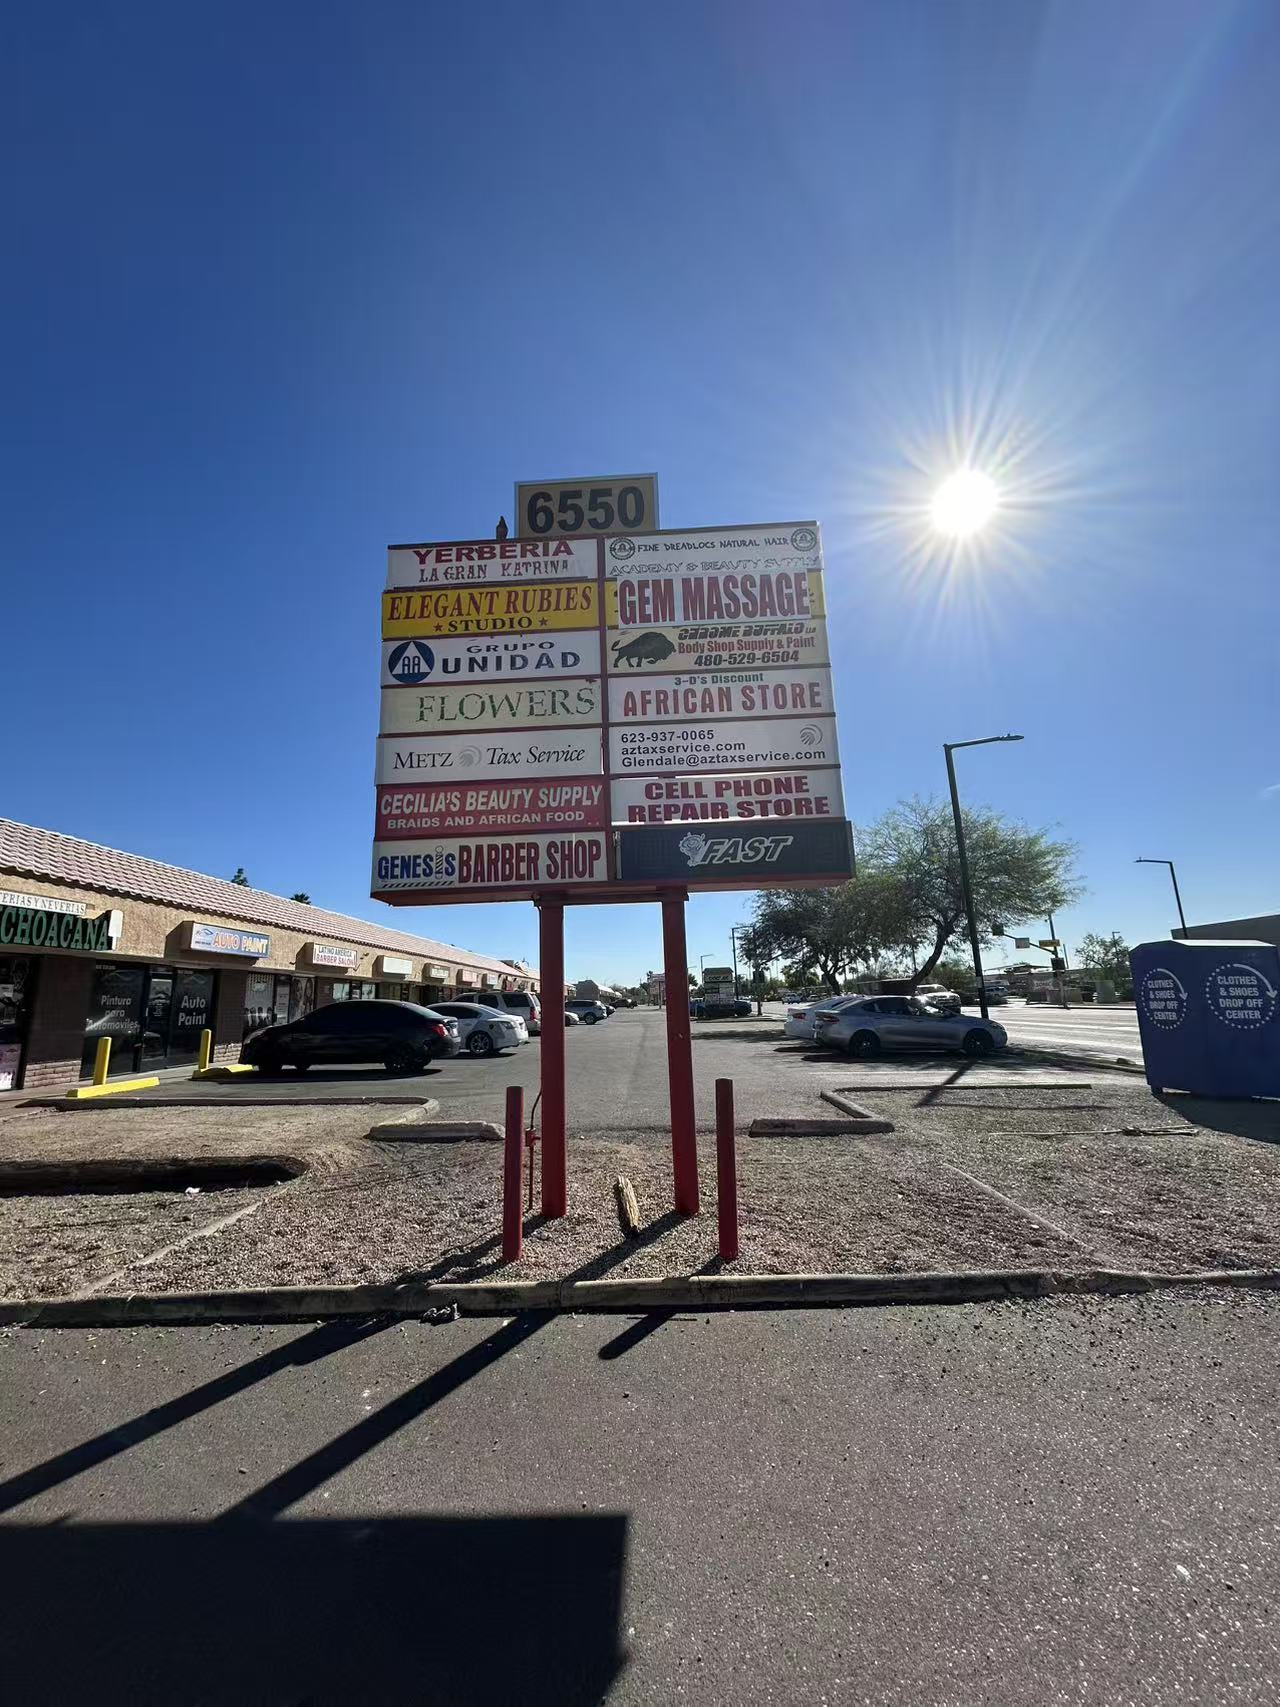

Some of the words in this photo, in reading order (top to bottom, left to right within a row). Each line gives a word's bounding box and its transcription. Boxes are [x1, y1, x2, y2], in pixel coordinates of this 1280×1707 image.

[527, 486, 645, 534] 6550
[412, 540, 574, 565] YERBERIA
[637, 543, 660, 553] FINE
[663, 541, 716, 551] DREADLOCS
[719, 539, 760, 549] NATURAL
[764, 537, 789, 546] HAIR
[418, 567, 439, 583] LA
[443, 564, 487, 581] GRAN
[500, 559, 569, 577] KATRINA
[609, 562, 683, 577] ACADEMY
[685, 562, 698, 571] &
[700, 559, 761, 571] BEAUTY
[387, 591, 500, 621] ELEGANT
[504, 585, 593, 614] RUBIES
[619, 578, 676, 626] GEM
[682, 571, 810, 622] MASSAGE
[447, 616, 533, 633] STUDIO
[678, 625, 742, 641] CHROME
[742, 622, 805, 637] BUFFALO
[466, 641, 555, 654] GRUPO
[678, 641, 705, 654] Body
[707, 640, 735, 653] Shop
[737, 638, 775, 651] Supply
[776, 638, 785, 649] &
[786, 635, 816, 648] Paint
[401, 655, 421, 674] AA
[441, 651, 581, 675] UNIDAD
[694, 650, 800, 667] 480-529-6504
[711, 673, 764, 684] Discount
[415, 687, 595, 722] FLOWERS
[623, 686, 733, 717] AFRICAN
[740, 682, 822, 711] STORE
[621, 729, 715, 743] 623-937-0065
[486, 747, 521, 765] Tax
[525, 744, 586, 763] Service
[621, 740, 746, 755] aztaxservice.com
[392, 752, 454, 770] METZ
[621, 750, 826, 768] Glendale@aztaxservice.com
[644, 781, 708, 800] CELL
[714, 776, 810, 798] PHONE
[381, 791, 461, 816] CECILIA'S
[465, 788, 534, 812] BEAUTY
[538, 785, 603, 808] SUPPLY
[627, 801, 730, 823] REPAIR
[736, 796, 830, 818] STORE
[387, 817, 440, 829] BRAIDS
[445, 816, 474, 827] AND
[478, 813, 541, 825] AFRICAN
[546, 811, 585, 822] FOOD
[700, 835, 794, 864] FAST
[458, 841, 540, 883] BARBER
[545, 839, 601, 880] SHOP
[39, 898, 86, 915] NEVERIAS
[0, 906, 109, 951] CHOACANA
[213, 931, 240, 950] AUTO
[241, 935, 268, 954] PAINT
[316, 954, 337, 964] BARBER
[1147, 979, 1174, 989] CLOTHES
[1217, 976, 1258, 985] CLOTHES
[101, 995, 132, 1006] Pintura
[1150, 990, 1155, 999] &
[1155, 990, 1176, 999] SHOES
[1219, 987, 1228, 996] &
[1229, 987, 1259, 996] SHOES
[181, 995, 206, 1009] Auto
[1150, 1001, 1167, 1010] DROP
[1167, 1001, 1179, 1010] OFF
[1219, 998, 1244, 1008] DROP
[1246, 998, 1263, 1008] OFF
[178, 1012, 206, 1026] Paint
[1153, 1011, 1178, 1020] CENTER
[1225, 1010, 1262, 1019] CENTER
